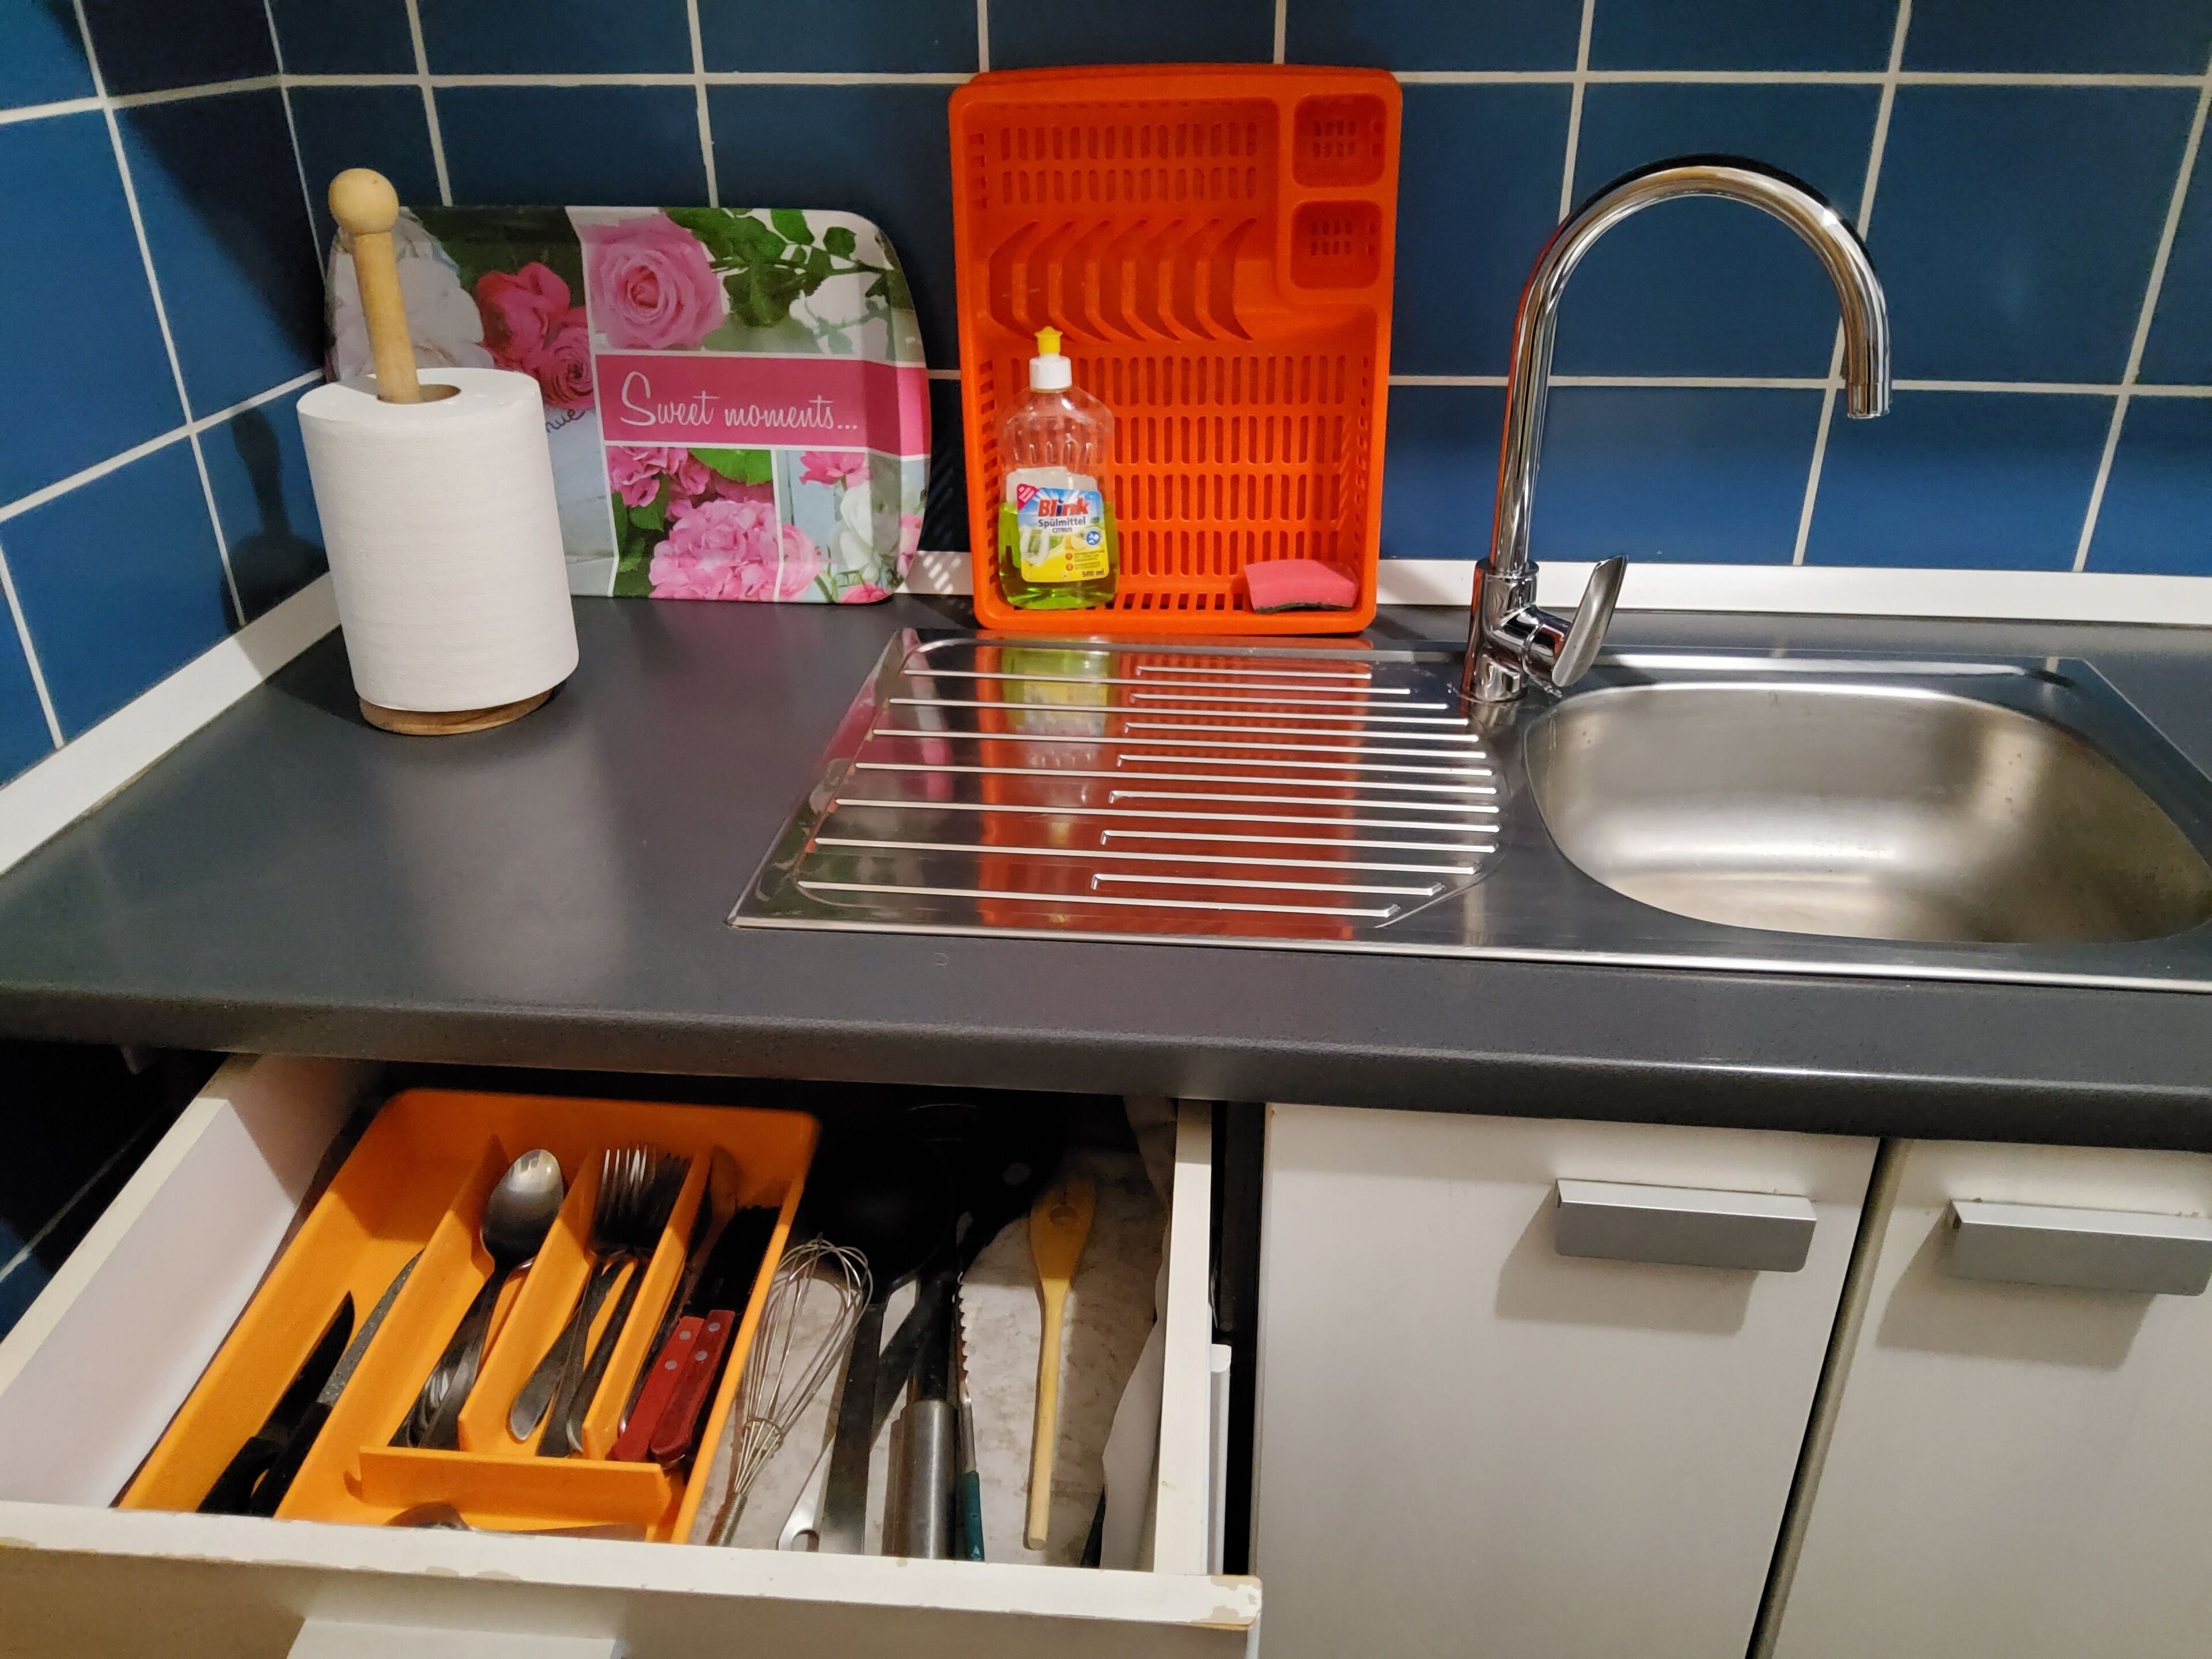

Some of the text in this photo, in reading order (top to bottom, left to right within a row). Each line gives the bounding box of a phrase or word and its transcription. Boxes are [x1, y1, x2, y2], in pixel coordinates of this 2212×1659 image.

[620, 371, 858, 431] Sweet moments...
[1038, 497, 1090, 517] Blink
[1038, 517, 1086, 529] Spülmittel
[1096, 568, 1104, 576] ml
